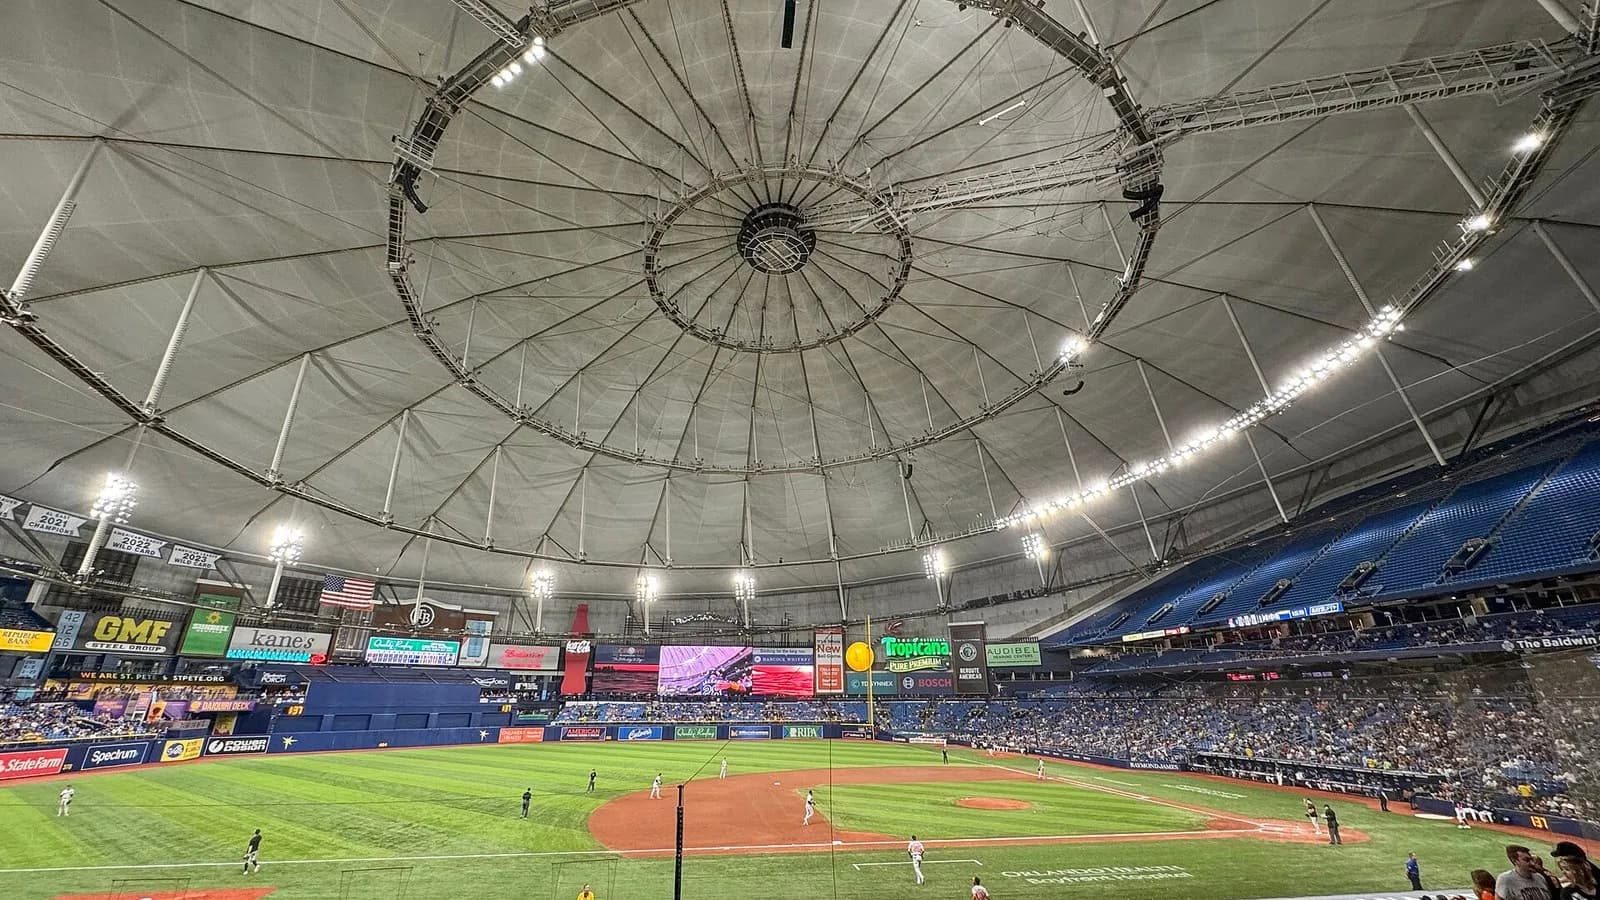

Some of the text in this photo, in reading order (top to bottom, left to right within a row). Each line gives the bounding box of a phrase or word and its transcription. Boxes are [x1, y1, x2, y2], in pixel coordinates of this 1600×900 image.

[39, 515, 68, 528] 2021
[28, 521, 74, 535] CHAMPIONS
[112, 541, 156, 556] WILD CARD
[121, 537, 151, 549] 2022
[174, 557, 212, 569] WILD CARD
[183, 552, 208, 563] 2023
[64, 613, 81, 623] 42
[61, 625, 73, 635] 12
[94, 615, 173, 644] GMF
[2, 631, 40, 640] REPUBLIC
[249, 630, 314, 649] kanes
[55, 637, 70, 647] 66
[881, 636, 949, 658] Tropicana
[1516, 635, 1597, 649] The Baldwin
[817, 644, 841, 653] New
[987, 646, 1039, 656] AUDIBEL
[889, 658, 942, 670] PURE PREMIUM
[98, 672, 118, 680] ARE
[918, 678, 953, 688] BOSCH
[232, 701, 251, 711] DECK
[91, 749, 137, 765] Spectrum
[1001, 868, 1105, 878] ORLANDO
